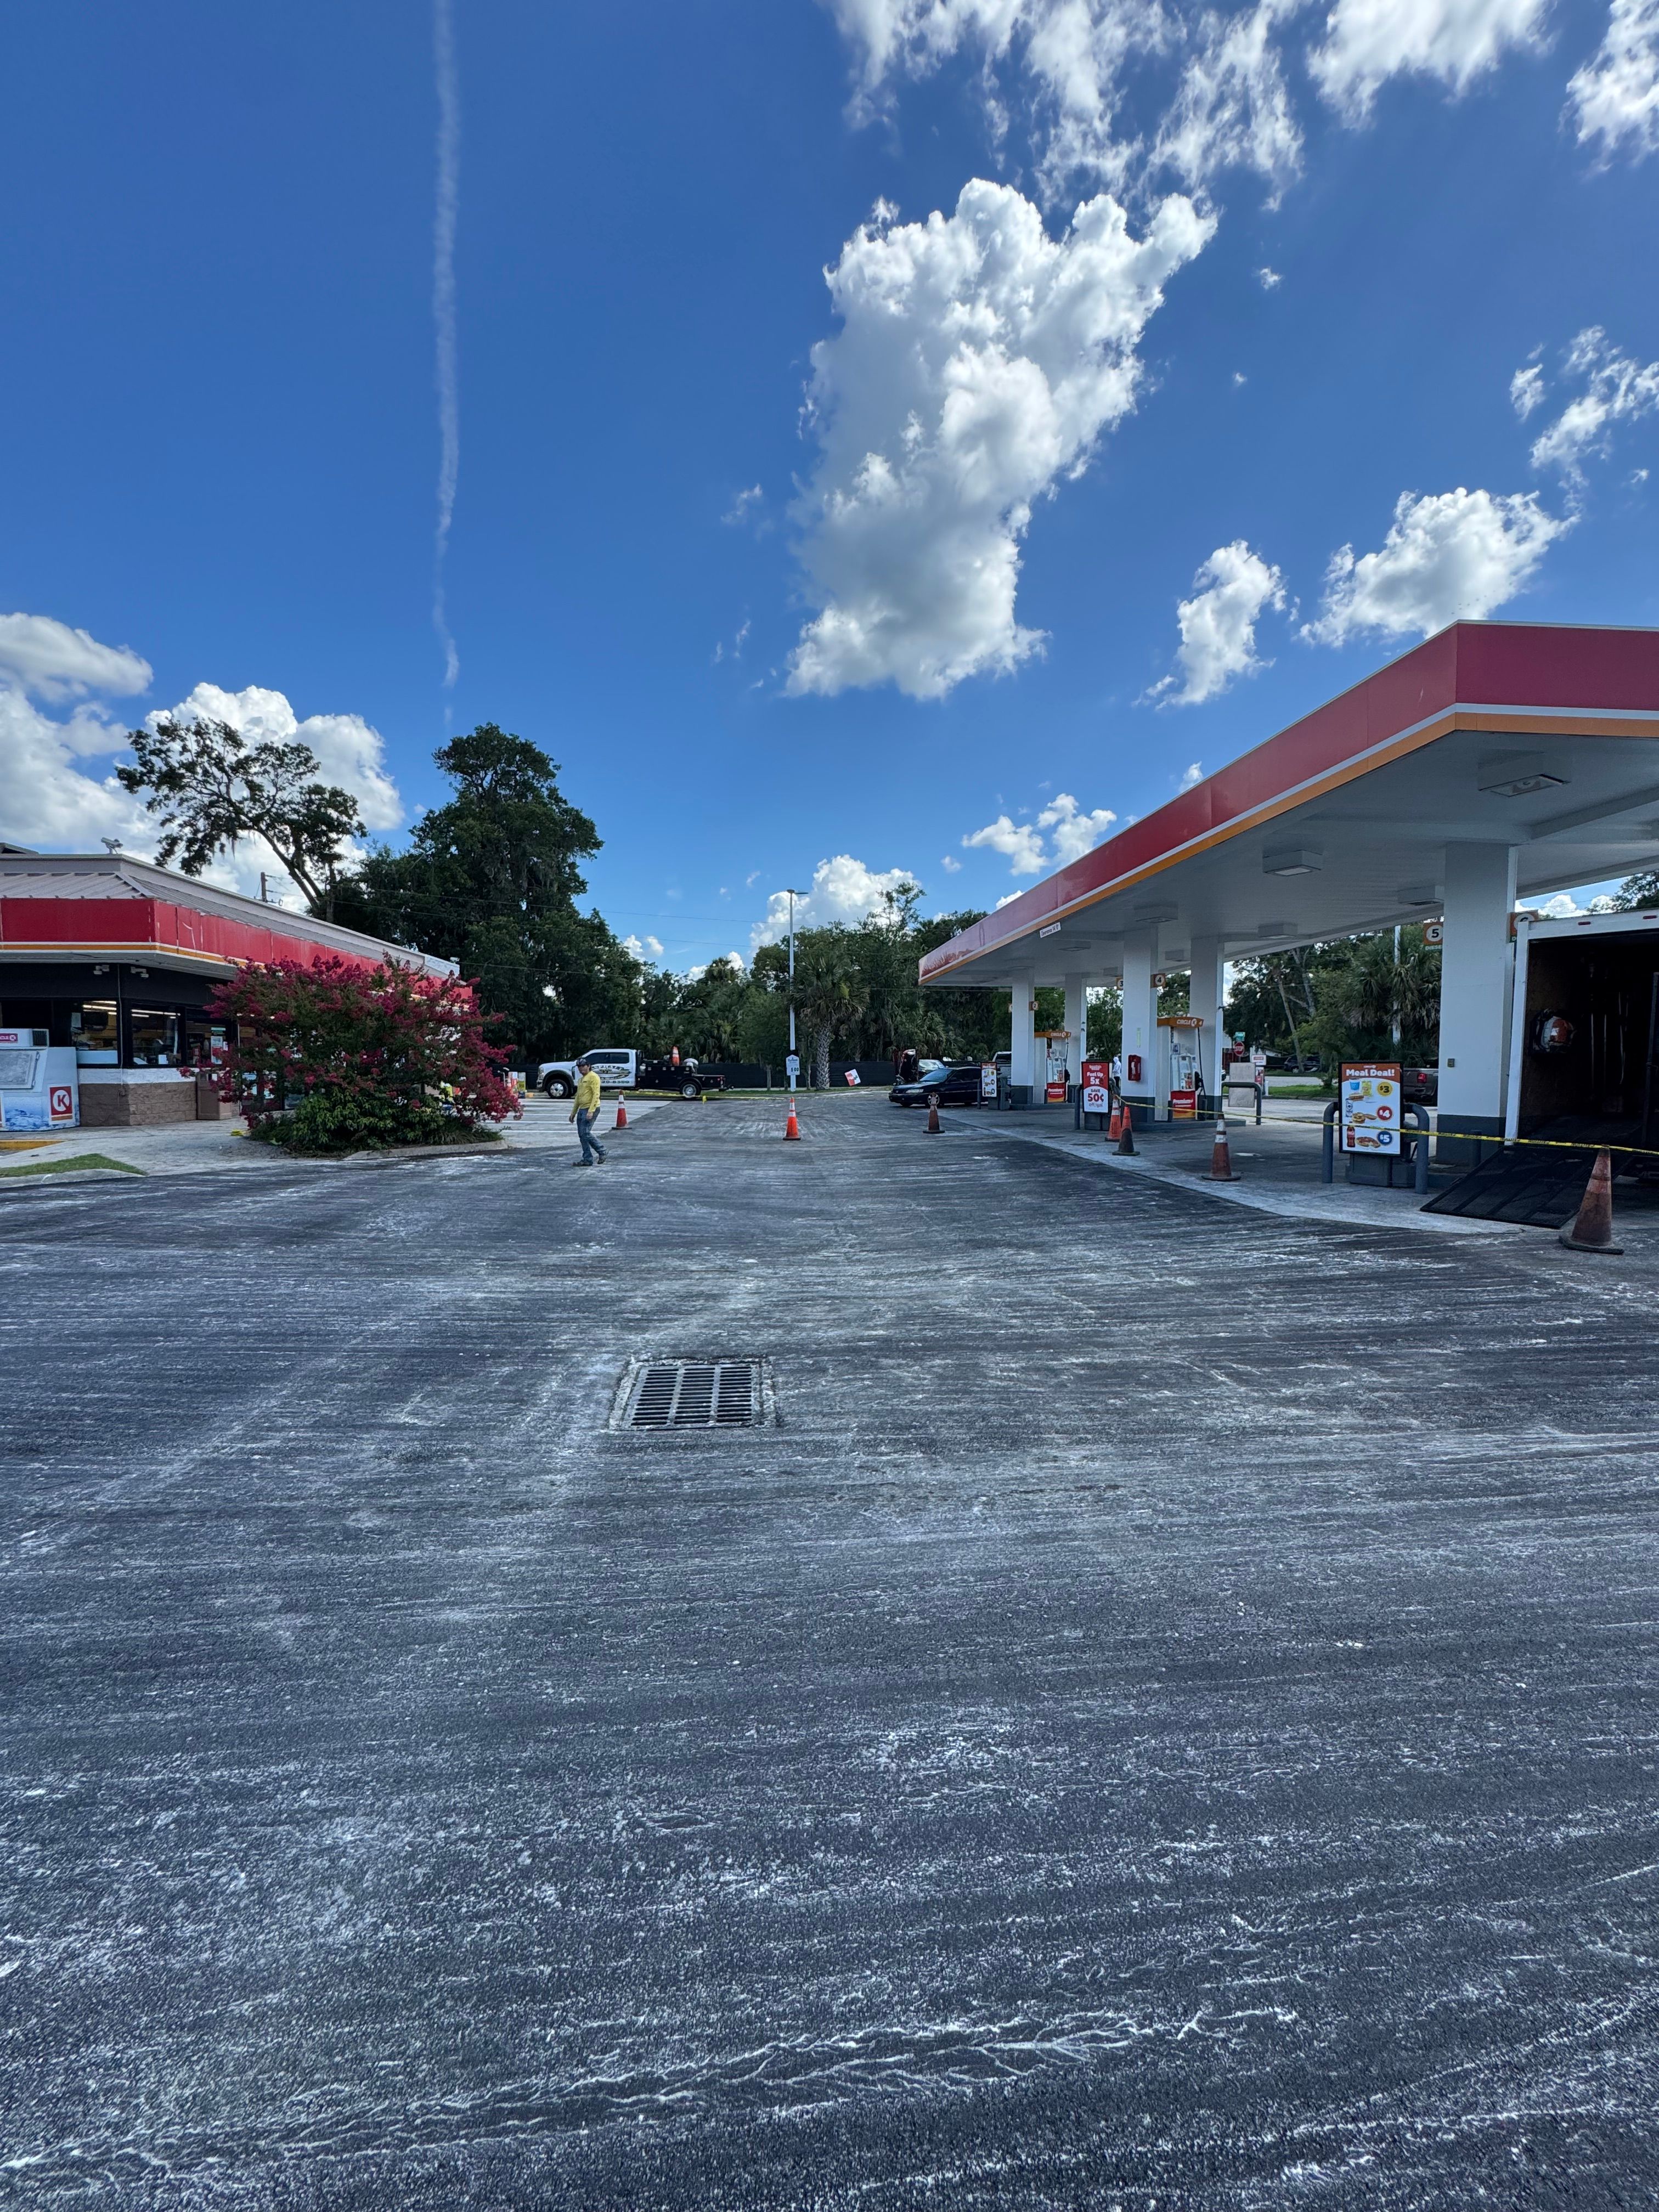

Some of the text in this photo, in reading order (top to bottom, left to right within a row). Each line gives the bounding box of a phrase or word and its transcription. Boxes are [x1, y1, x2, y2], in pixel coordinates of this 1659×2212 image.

[1431, 928, 1440, 939] 5
[1087, 1093, 1104, 1102] 50¢
[1379, 1109, 1391, 1118] $4
[1380, 1134, 1390, 1143] $5
